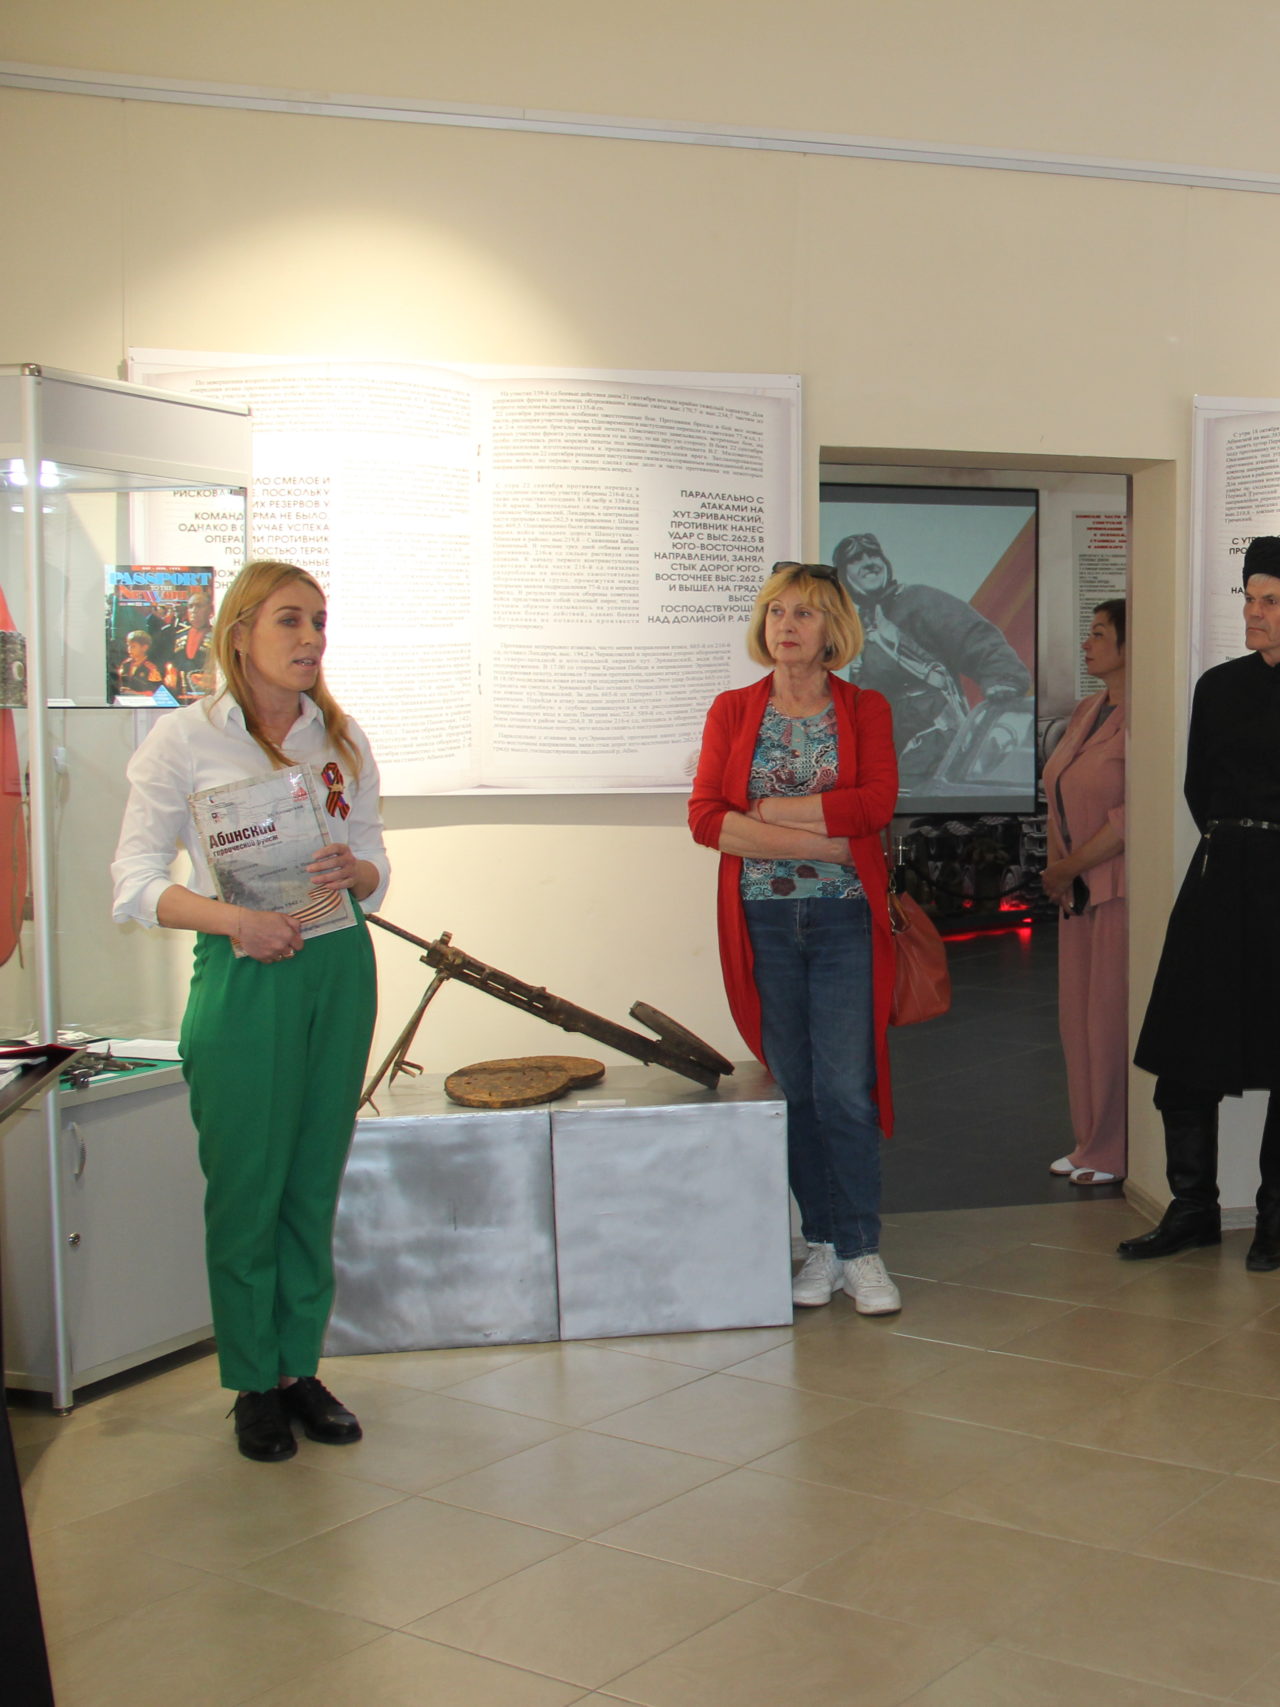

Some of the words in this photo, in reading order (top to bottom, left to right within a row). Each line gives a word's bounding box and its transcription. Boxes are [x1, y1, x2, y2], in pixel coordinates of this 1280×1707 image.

[274, 477, 319, 485] СМЕЛОЕ
[262, 488, 330, 497] ПОСКОЛЬКУ
[680, 490, 755, 503] ПАРАЛЛЕЛЬНО
[756, 496, 764, 504] С
[269, 500, 320, 508] РЕЗЕРВОВ
[700, 502, 748, 513] АТАКАМИ
[750, 506, 764, 514] НА
[194, 512, 276, 521] КОМАНДРМА
[280, 512, 292, 520] НЕ
[178, 523, 228, 532] ОДНАКО
[231, 523, 237, 531] В
[288, 523, 330, 531] УСПЕХА
[670, 521, 728, 531] ПРОТИВНИК
[730, 525, 764, 533] НАНЕС
[267, 535, 329, 543] ПРОТИВНИК
[668, 531, 695, 540] УДАР
[1232, 537, 1239, 545] С
[300, 547, 330, 555] ТЕРЯЛ
[672, 542, 764, 553] ЮГО-ВОСТОЧНОМ
[670, 563, 697, 571] СТЫК
[700, 564, 735, 572] ДОРОГ
[737, 564, 764, 572] ЮГО-
[110, 571, 212, 586] PASSPORT
[655, 573, 712, 582] ВОСТОЧНЕЕ
[669, 584, 676, 592] И
[678, 584, 715, 592] ВЫШЕЛ
[717, 584, 731, 592] НА
[734, 585, 762, 593] ГРЯДУ
[728, 594, 757, 602] ВЫСО
[661, 604, 753, 613] ГОСПОДСТВУЮЩ
[647, 616, 670, 624] НАД
[672, 614, 726, 624] ДОЛИНОЙ
